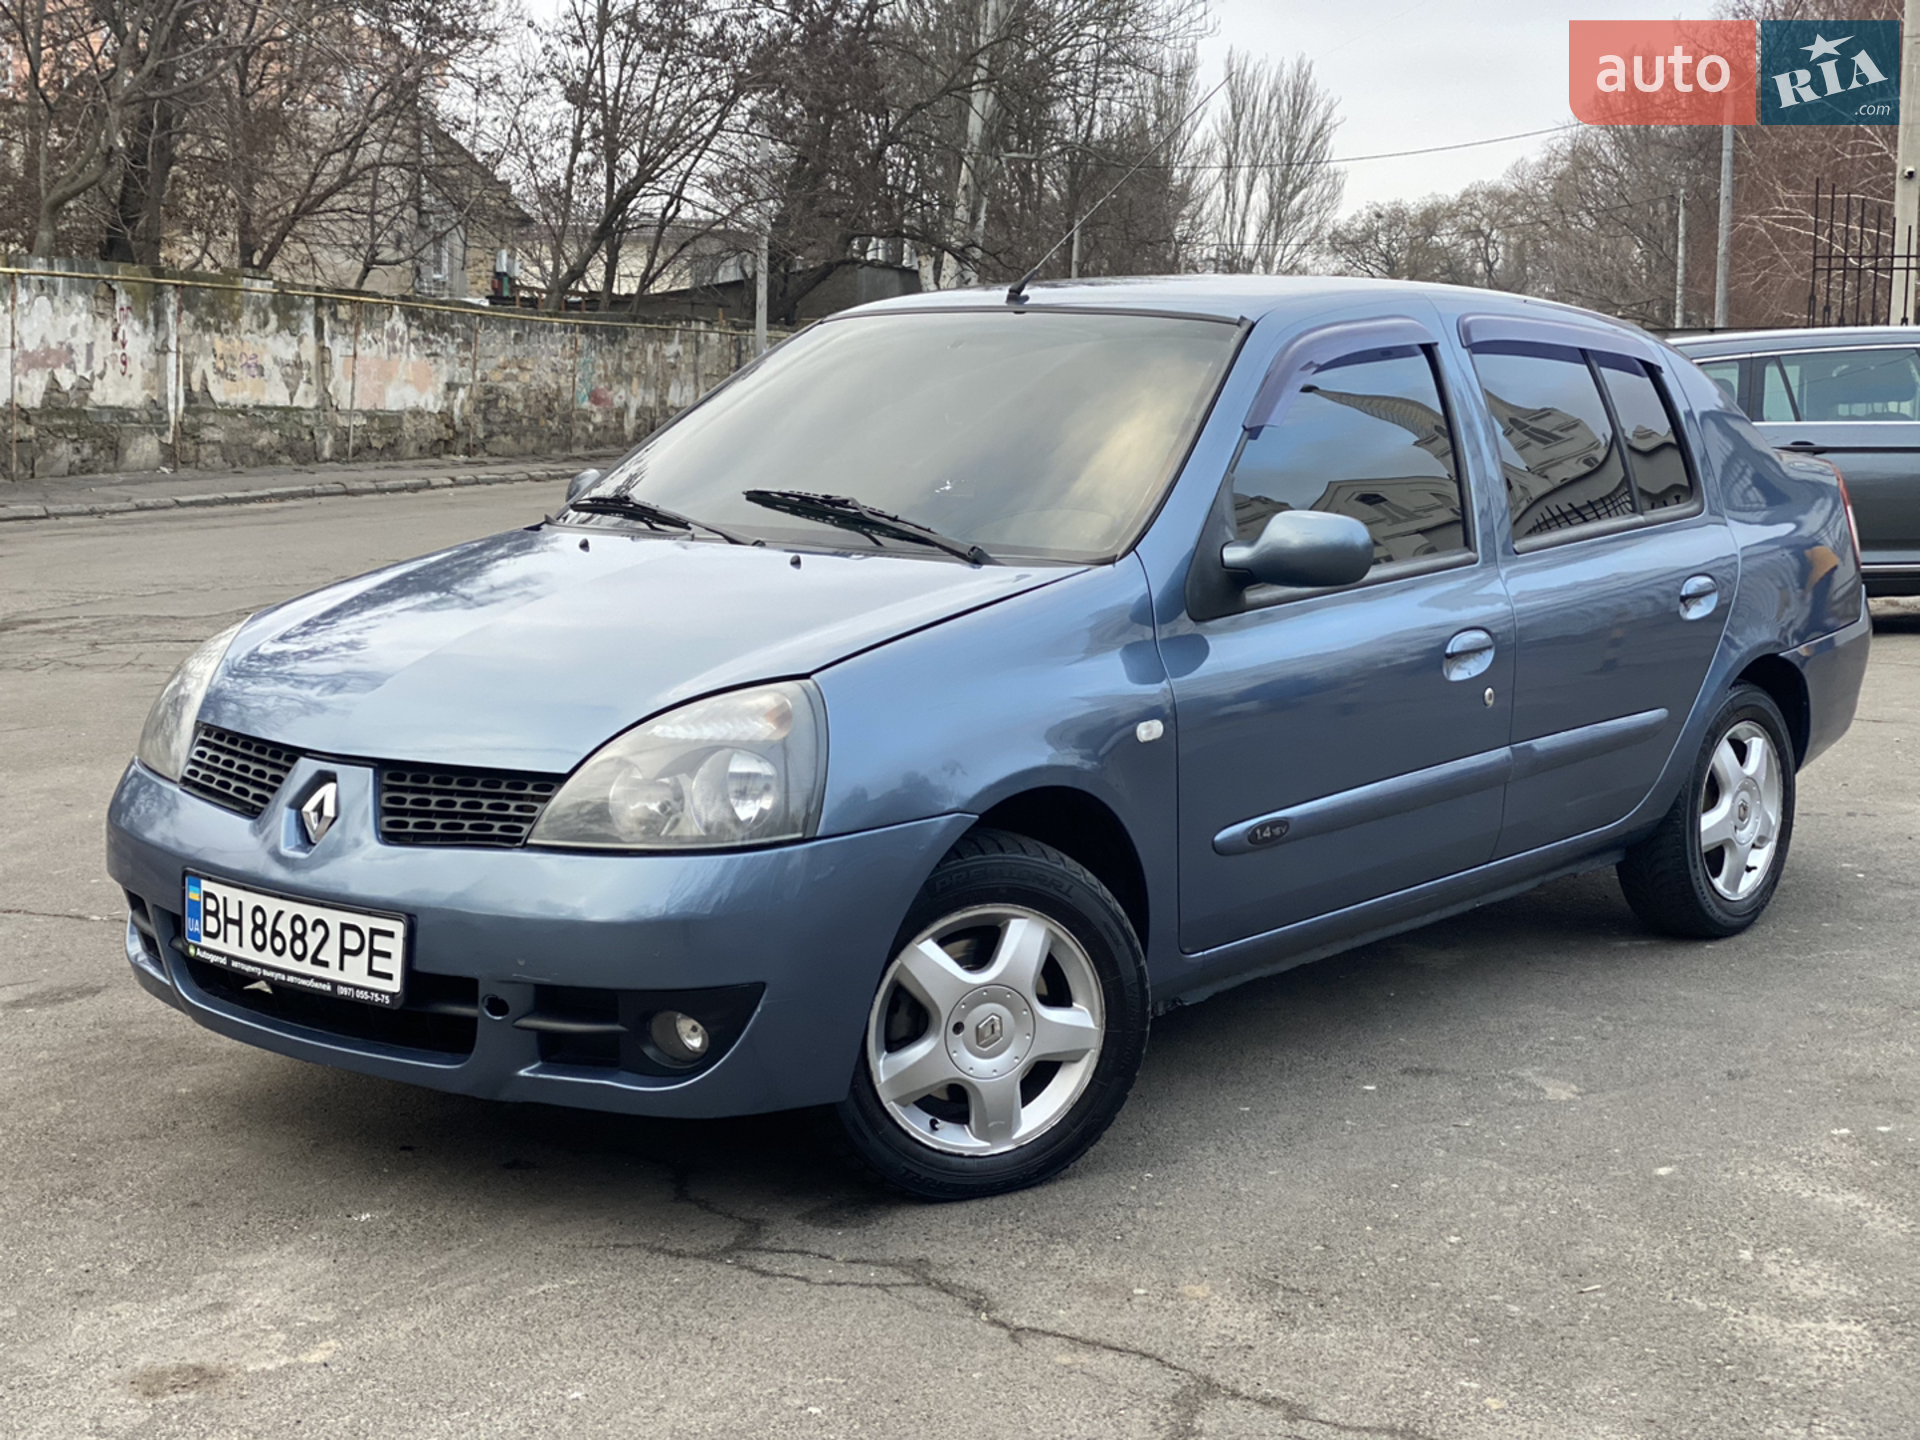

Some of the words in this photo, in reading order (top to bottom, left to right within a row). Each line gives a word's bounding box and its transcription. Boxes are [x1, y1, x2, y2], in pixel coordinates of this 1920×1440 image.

[188, 919, 201, 933] UA
[202, 889, 243, 948] BH
[251, 905, 330, 968] 8682
[338, 921, 395, 981] PE
[196, 948, 227, 965] Autogorod
[231, 960, 262, 977] автоцентр
[262, 968, 286, 984] выкупа
[286, 973, 332, 993] автомобилей
[337, 985, 355, 999] (097)
[355, 989, 390, 1004] 055-75-75
